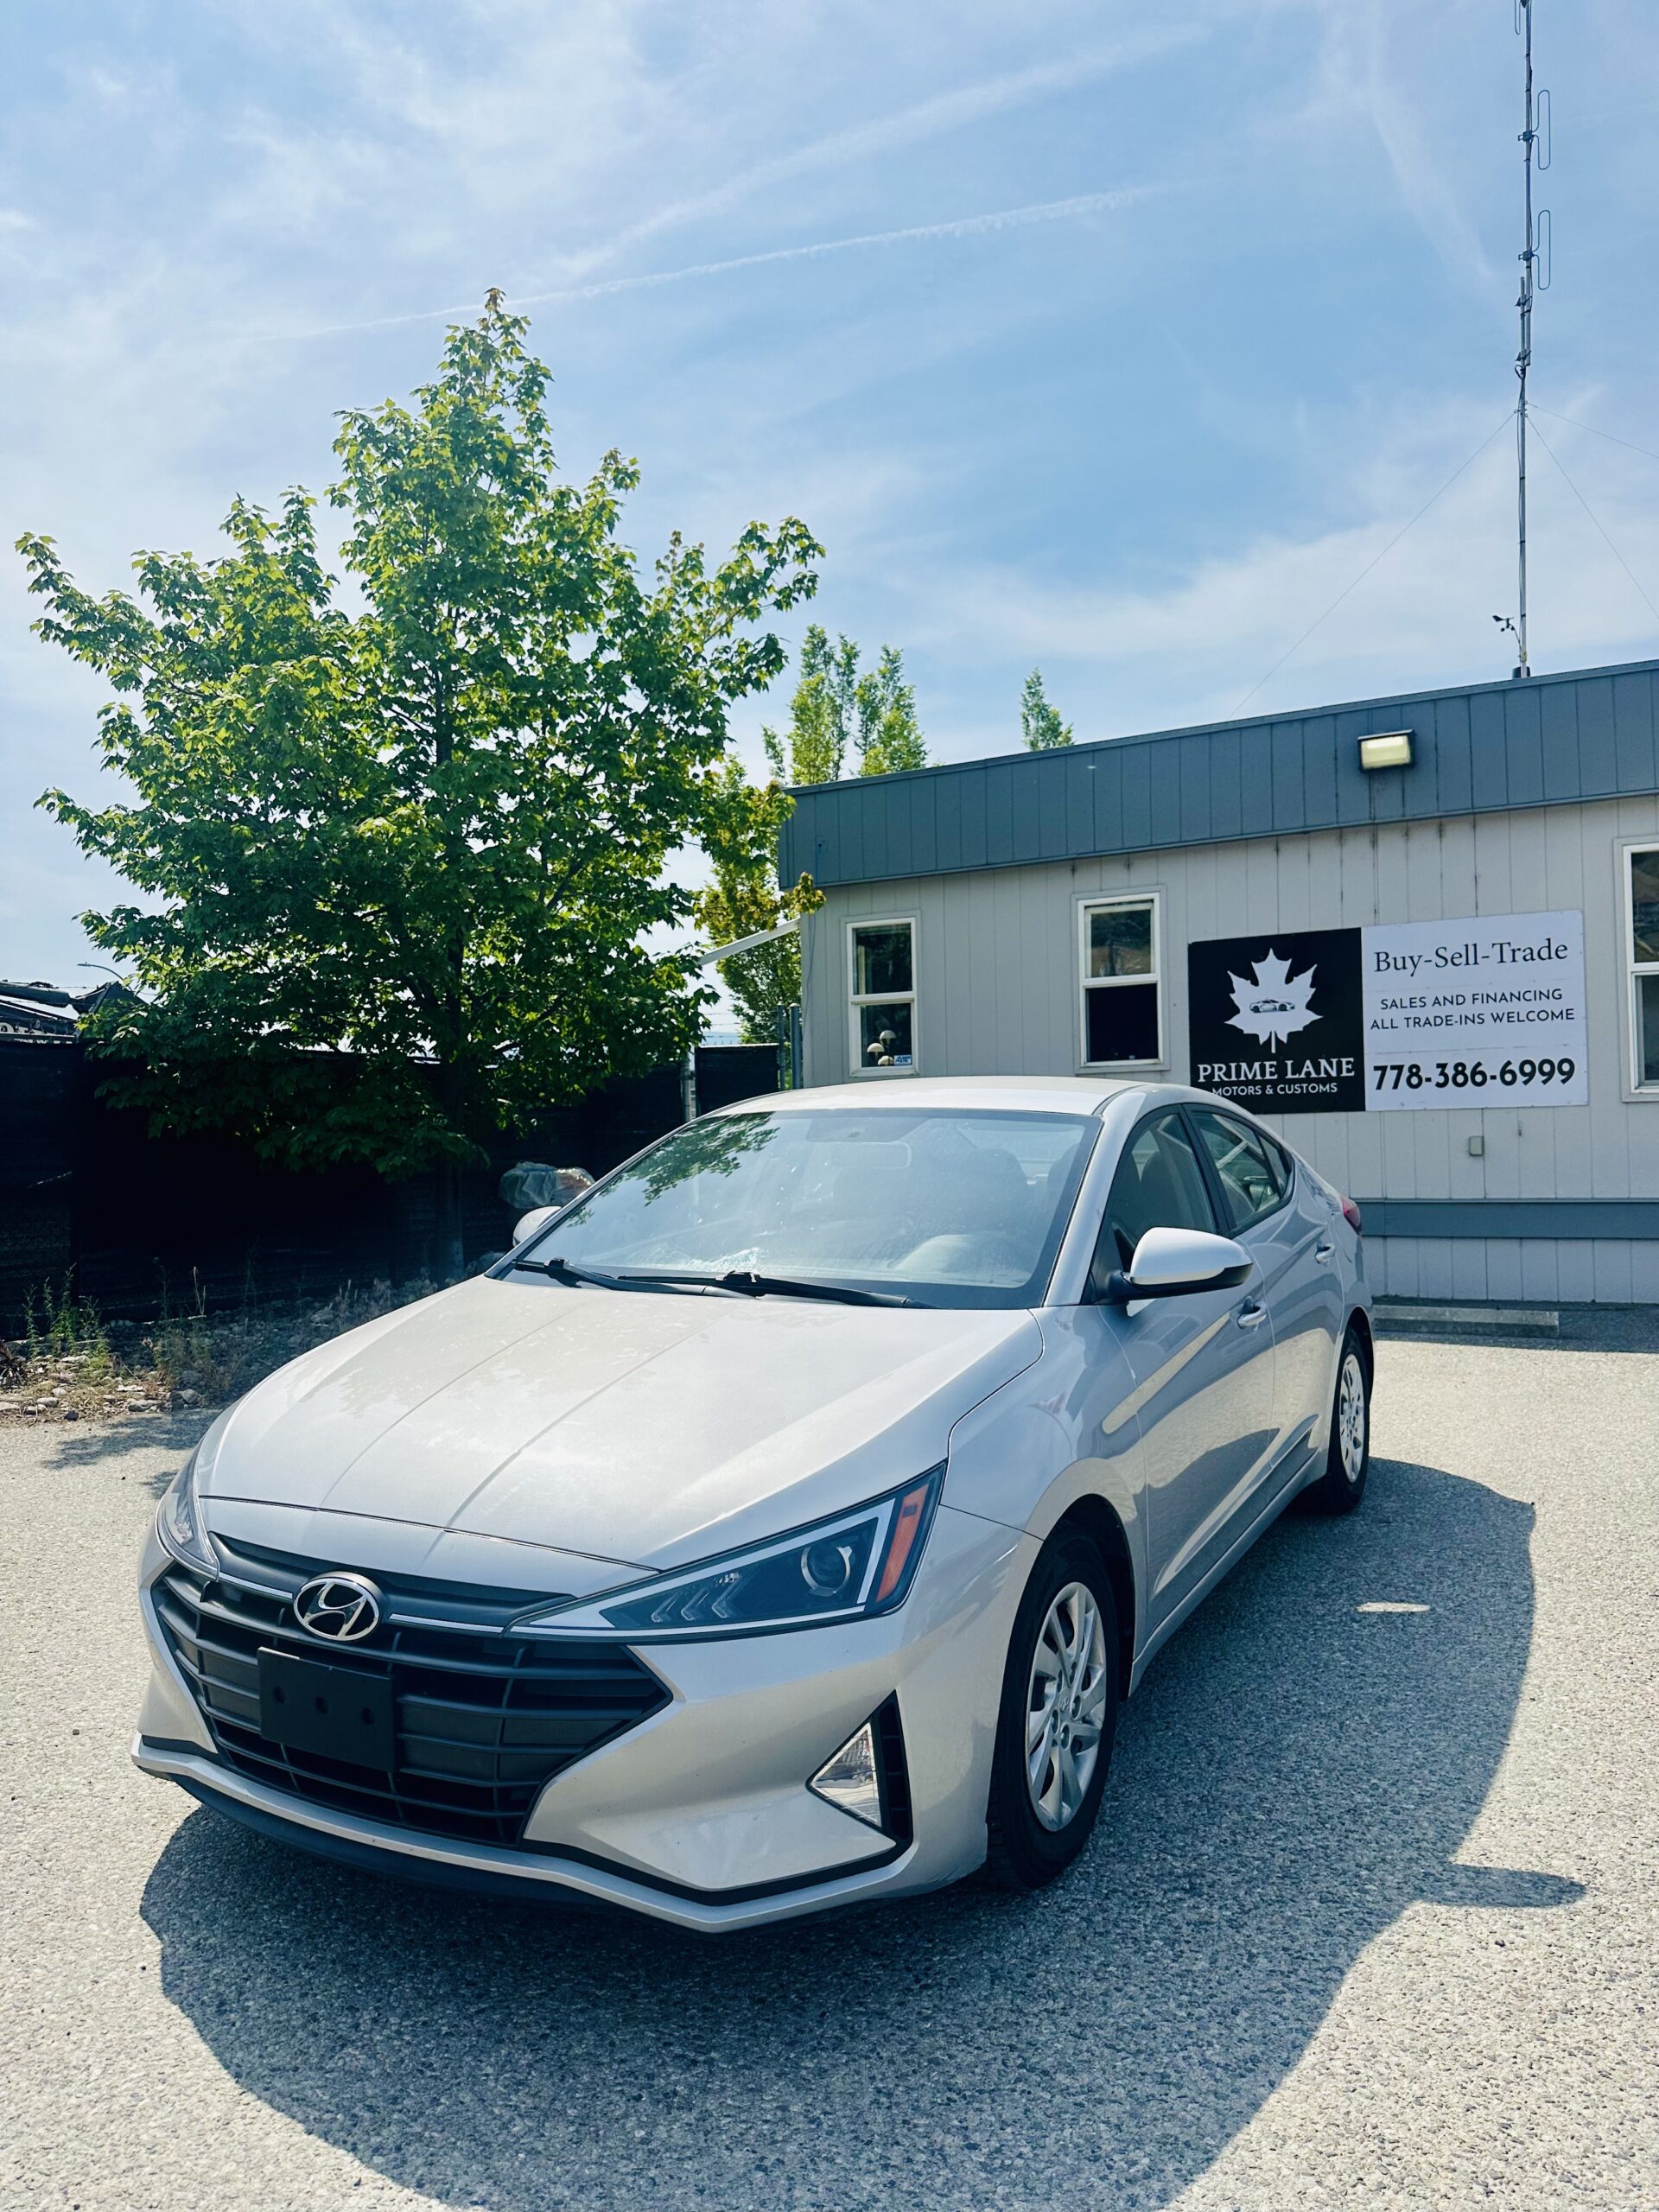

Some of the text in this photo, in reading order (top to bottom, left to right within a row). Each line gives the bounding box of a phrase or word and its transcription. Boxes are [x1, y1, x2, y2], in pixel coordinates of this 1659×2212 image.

[1374, 938, 1568, 976] Buy-Sell-Trade
[1380, 988, 1563, 1010] SALES AND FINANCING
[1370, 1008, 1575, 1030] ALL TRADE-INS WELCOME
[1197, 1058, 1355, 1082] PRIME LANE
[1373, 1058, 1575, 1090] 778-386-6999
[1211, 1082, 1338, 1096] MOTORS & CUSTOMS
